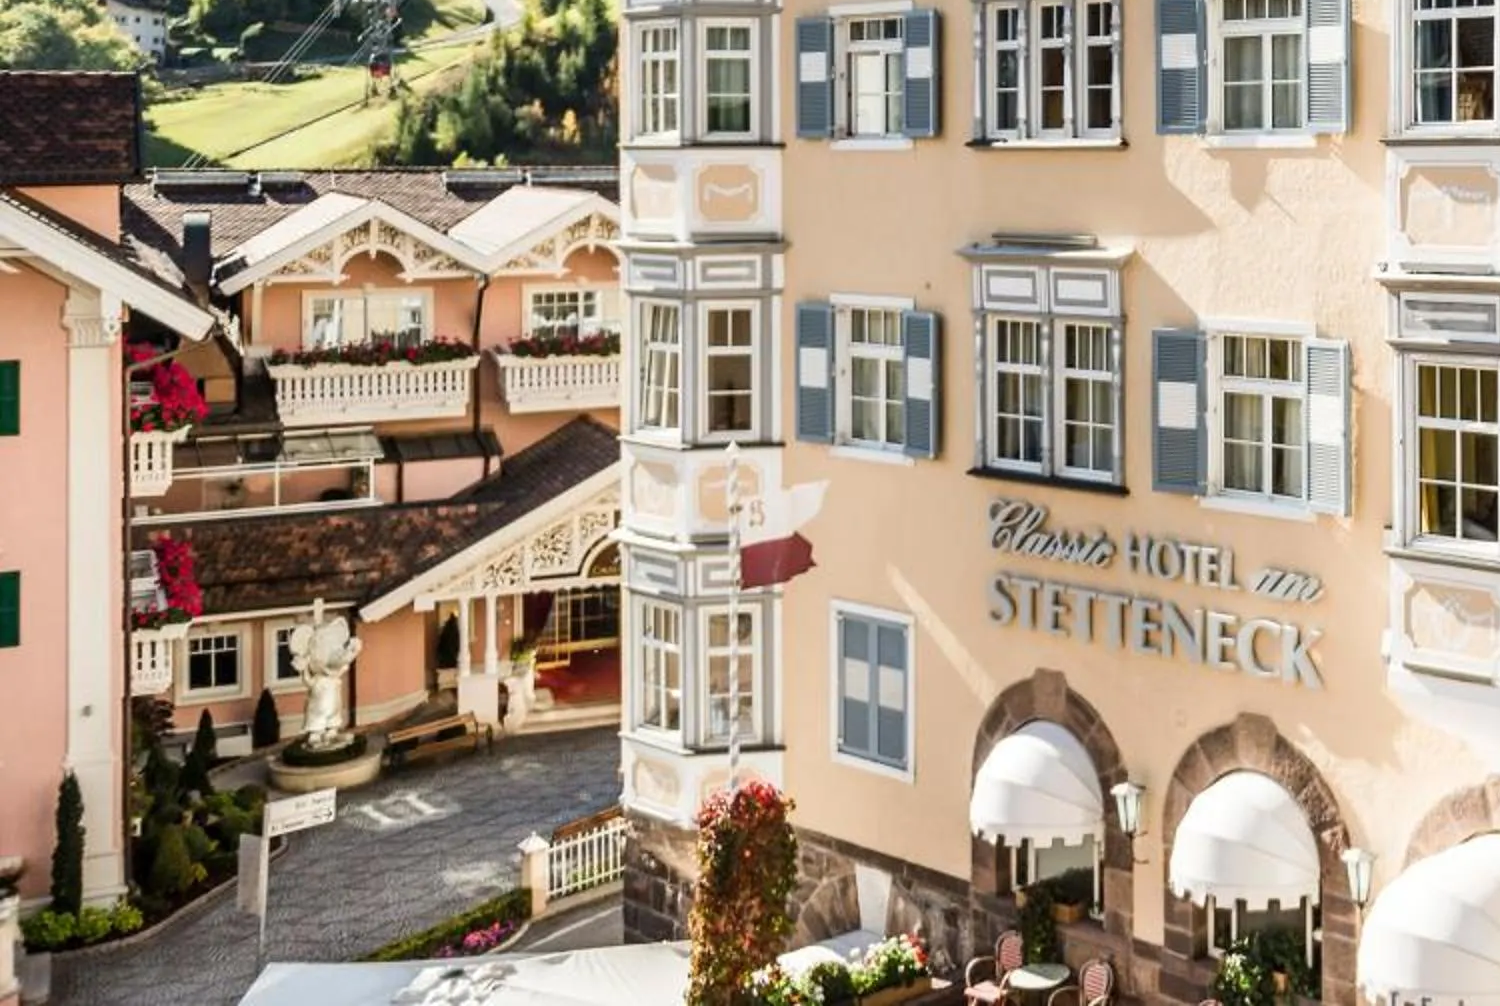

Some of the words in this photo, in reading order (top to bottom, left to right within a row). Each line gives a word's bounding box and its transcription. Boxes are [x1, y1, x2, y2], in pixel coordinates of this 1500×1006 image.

[988, 498, 1117, 568] Classic
[1125, 530, 1240, 591] HOTEL
[1250, 567, 1325, 603] am
[987, 571, 1325, 691] STETTENECK
